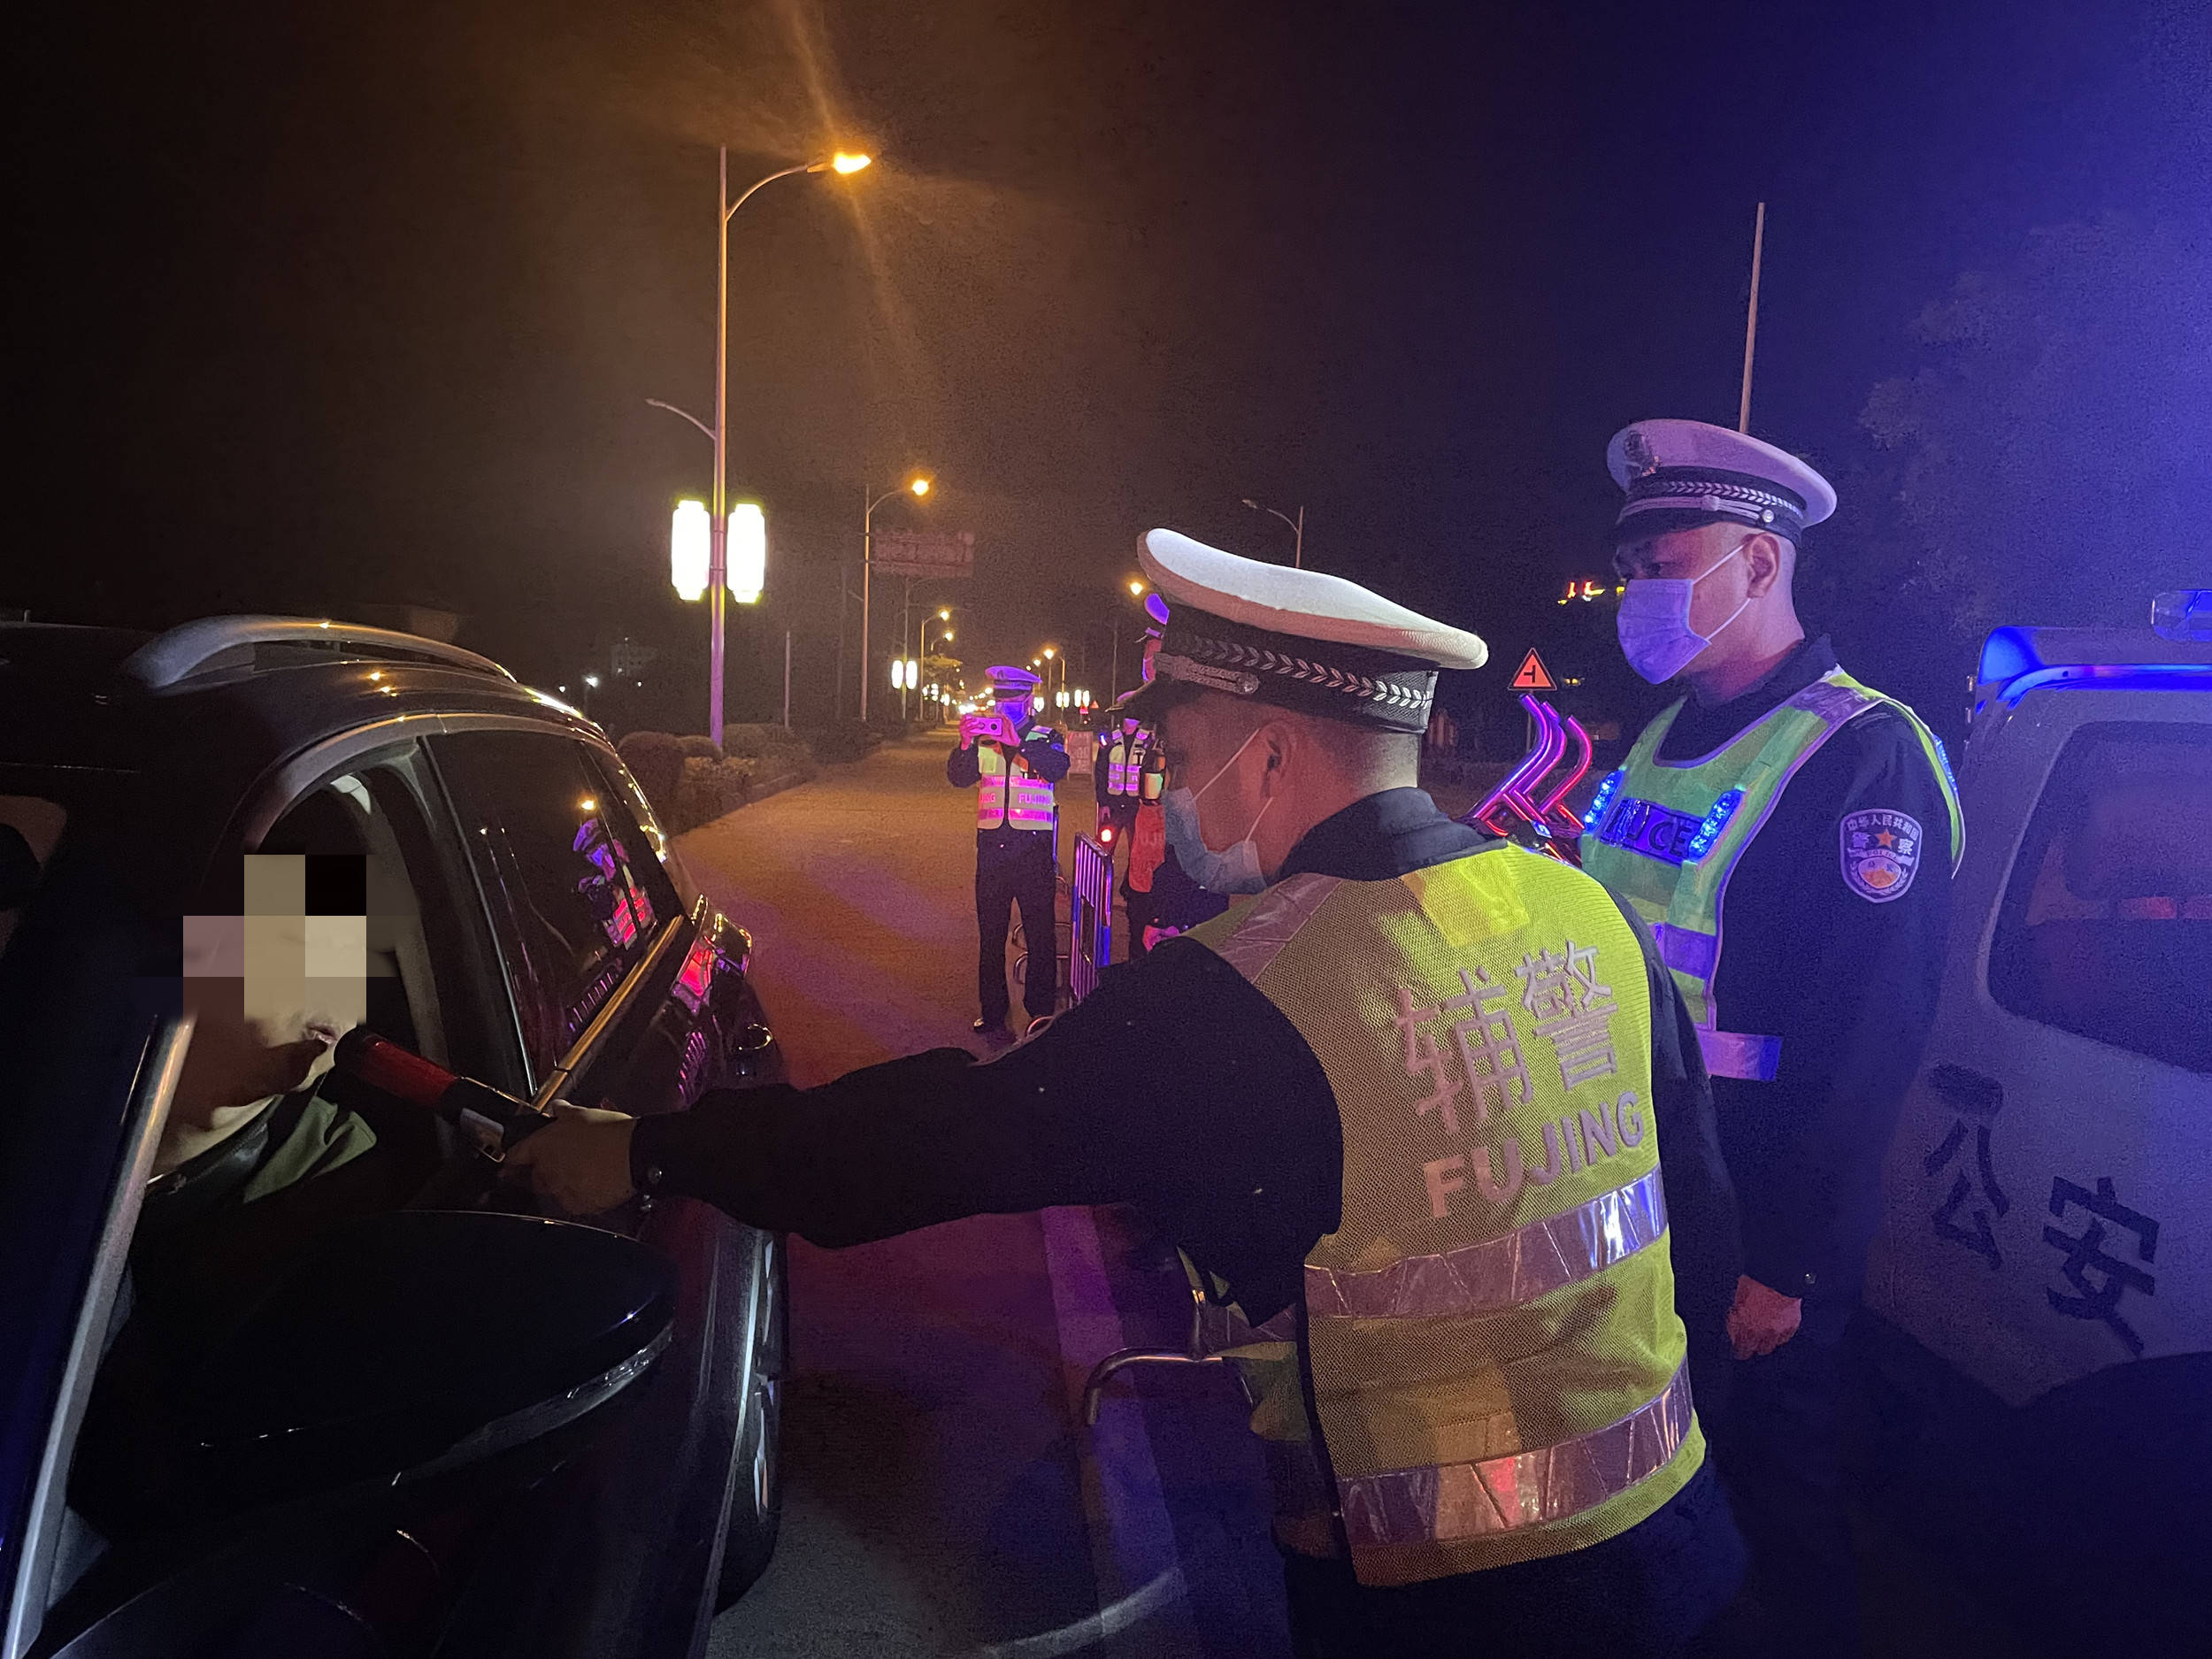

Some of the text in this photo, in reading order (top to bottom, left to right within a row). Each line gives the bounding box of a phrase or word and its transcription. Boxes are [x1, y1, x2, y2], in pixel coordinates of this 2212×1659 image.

[1847, 814, 1919, 841] 中华人民共和国
[1393, 940, 1619, 1135] 辅警
[1424, 1091, 1645, 1219] FUJING
[1923, 1118, 2161, 1357] 公安
